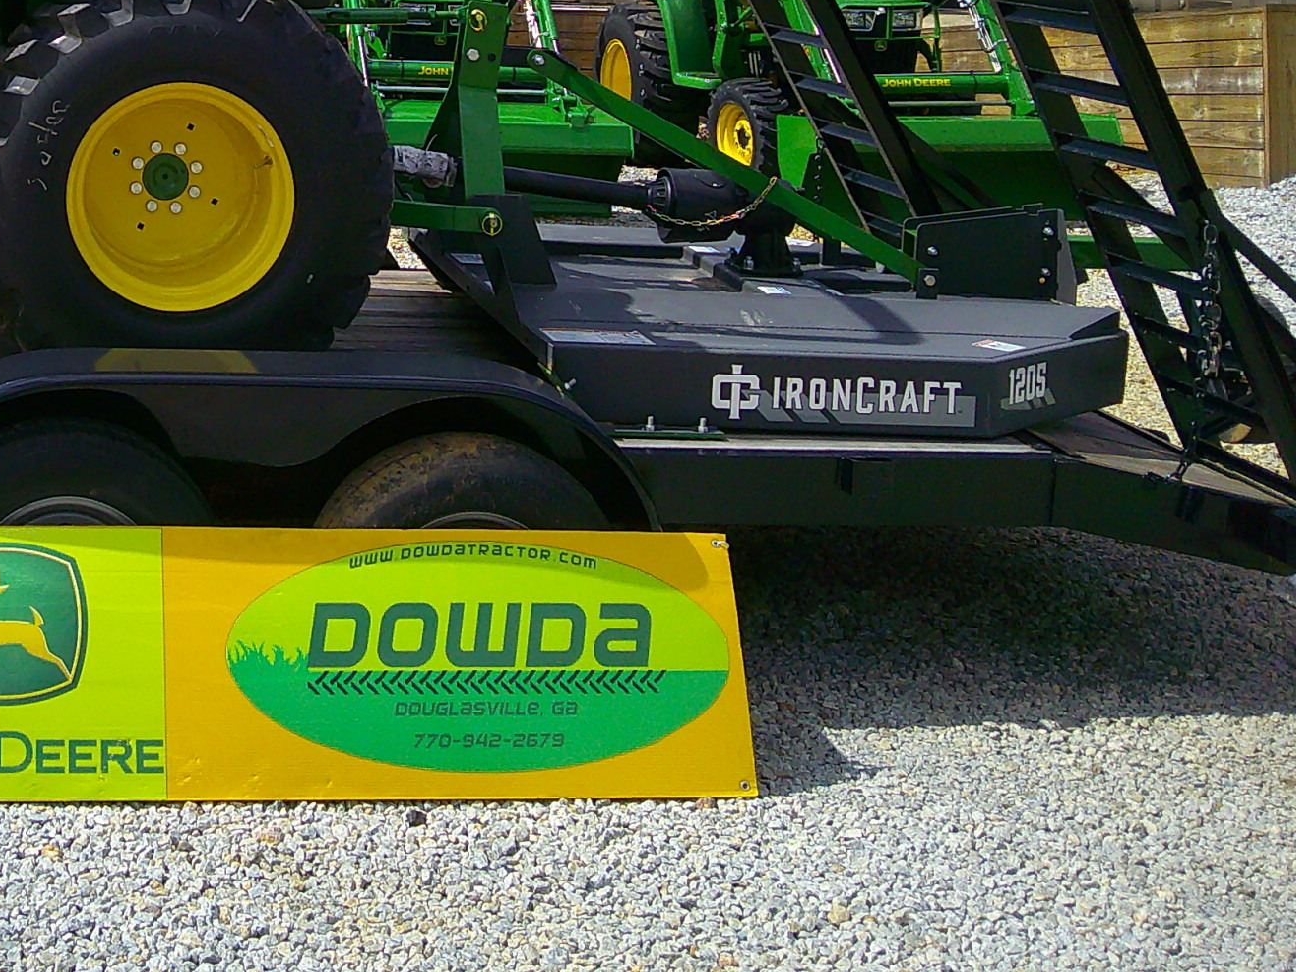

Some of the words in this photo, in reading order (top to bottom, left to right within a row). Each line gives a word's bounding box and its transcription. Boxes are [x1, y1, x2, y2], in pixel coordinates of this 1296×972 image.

[418, 66, 449, 75] JOHN
[882, 78, 912, 88] JOHN
[913, 77, 952, 88] DEERE
[1008, 361, 1048, 406] 1205
[771, 375, 963, 416] IRONCRAFT
[413, 733, 566, 749] 770-942-2679
